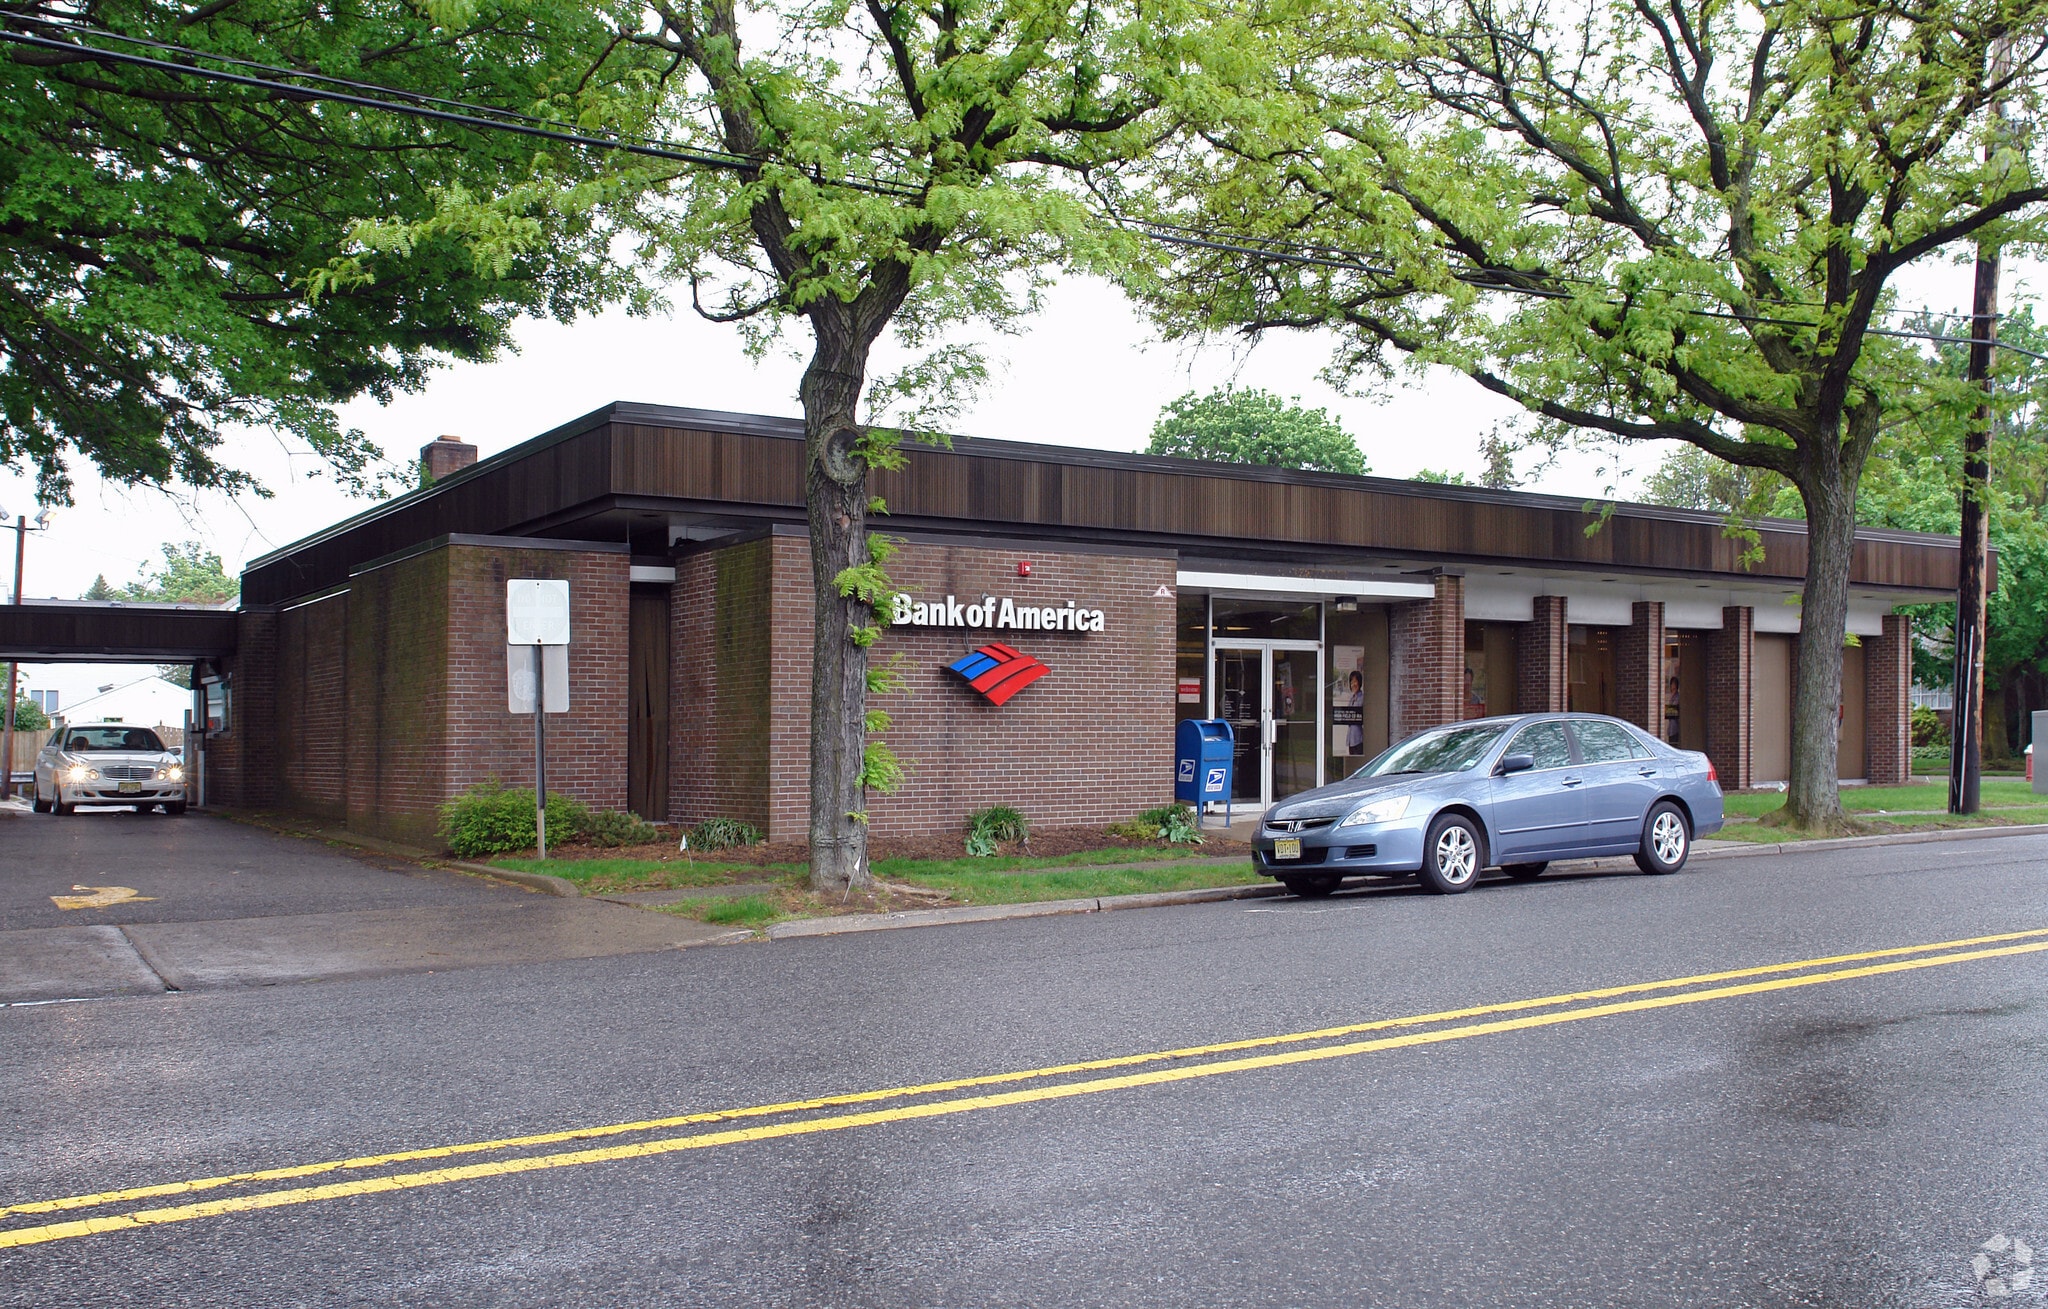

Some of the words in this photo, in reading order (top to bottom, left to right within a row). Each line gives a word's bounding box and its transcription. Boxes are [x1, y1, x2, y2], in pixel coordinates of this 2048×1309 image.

[892, 593, 965, 627] Bank
[966, 596, 996, 629] of
[997, 597, 1105, 632] America
[523, 621, 556, 631] ENER
